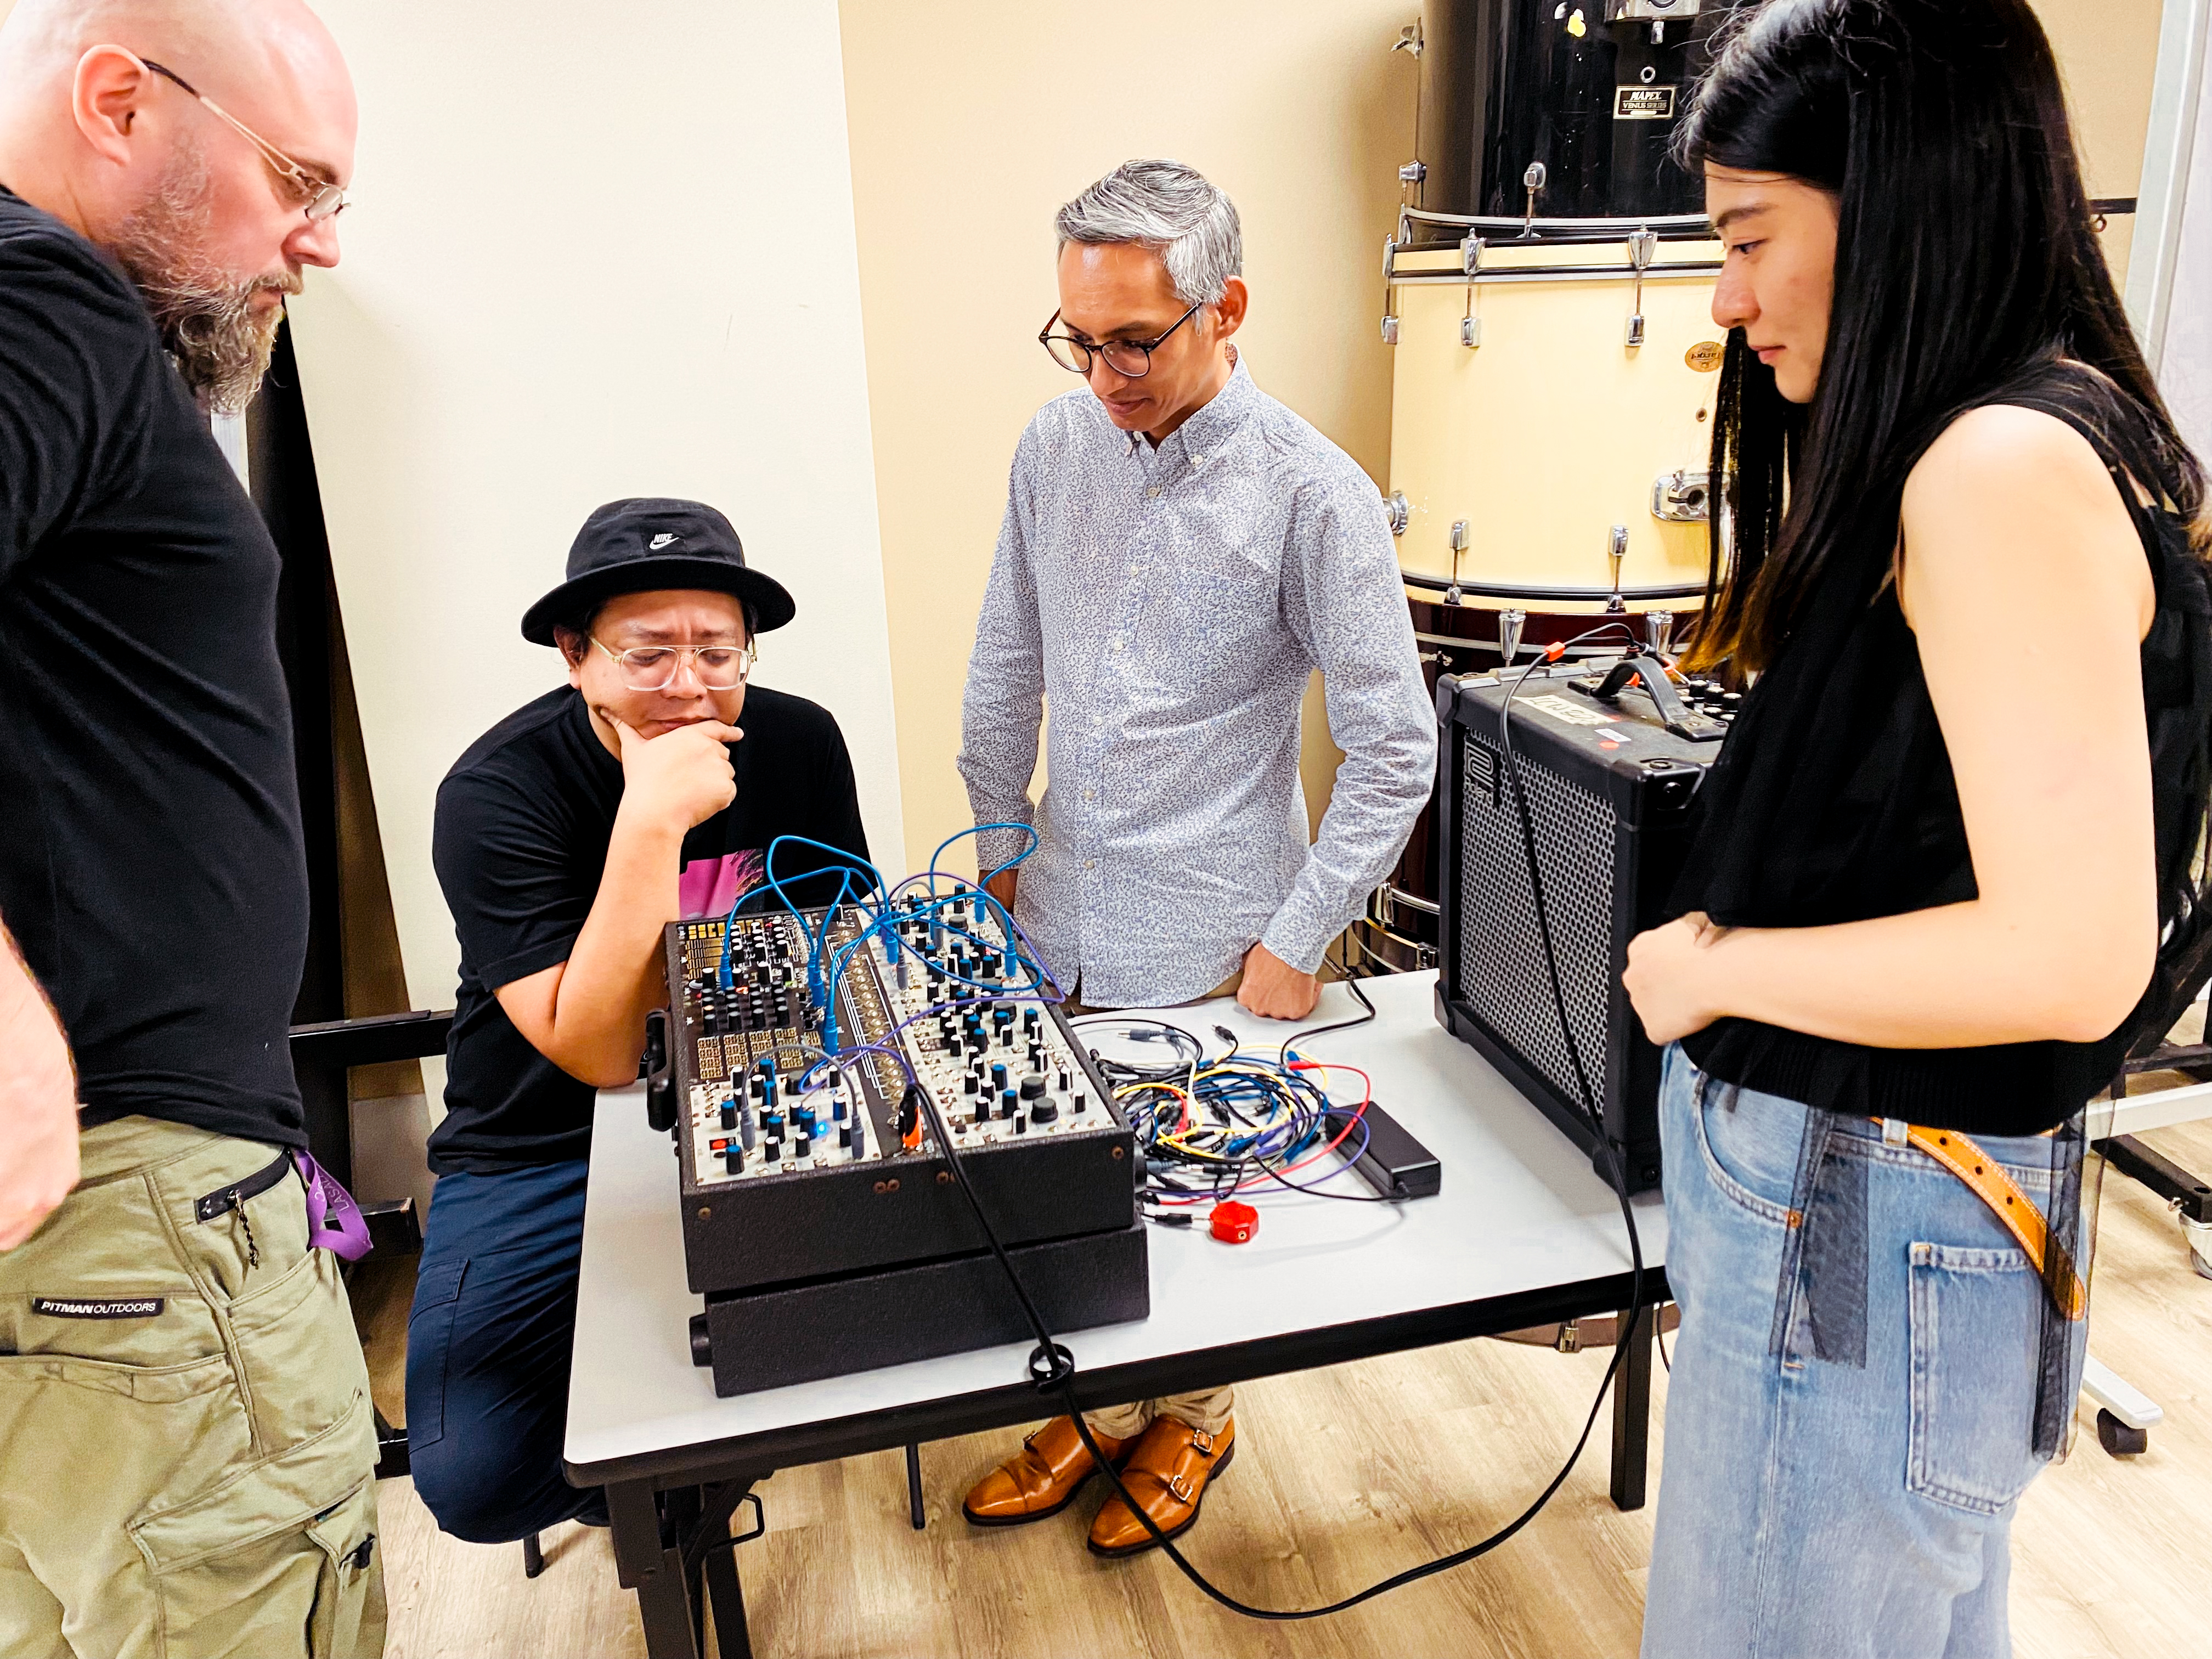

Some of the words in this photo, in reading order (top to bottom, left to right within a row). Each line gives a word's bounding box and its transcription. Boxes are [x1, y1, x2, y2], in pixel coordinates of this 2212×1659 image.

[1630, 91, 1662, 100] MAPEX
[653, 533, 673, 543] NIKE
[1463, 775, 1494, 806] Roland
